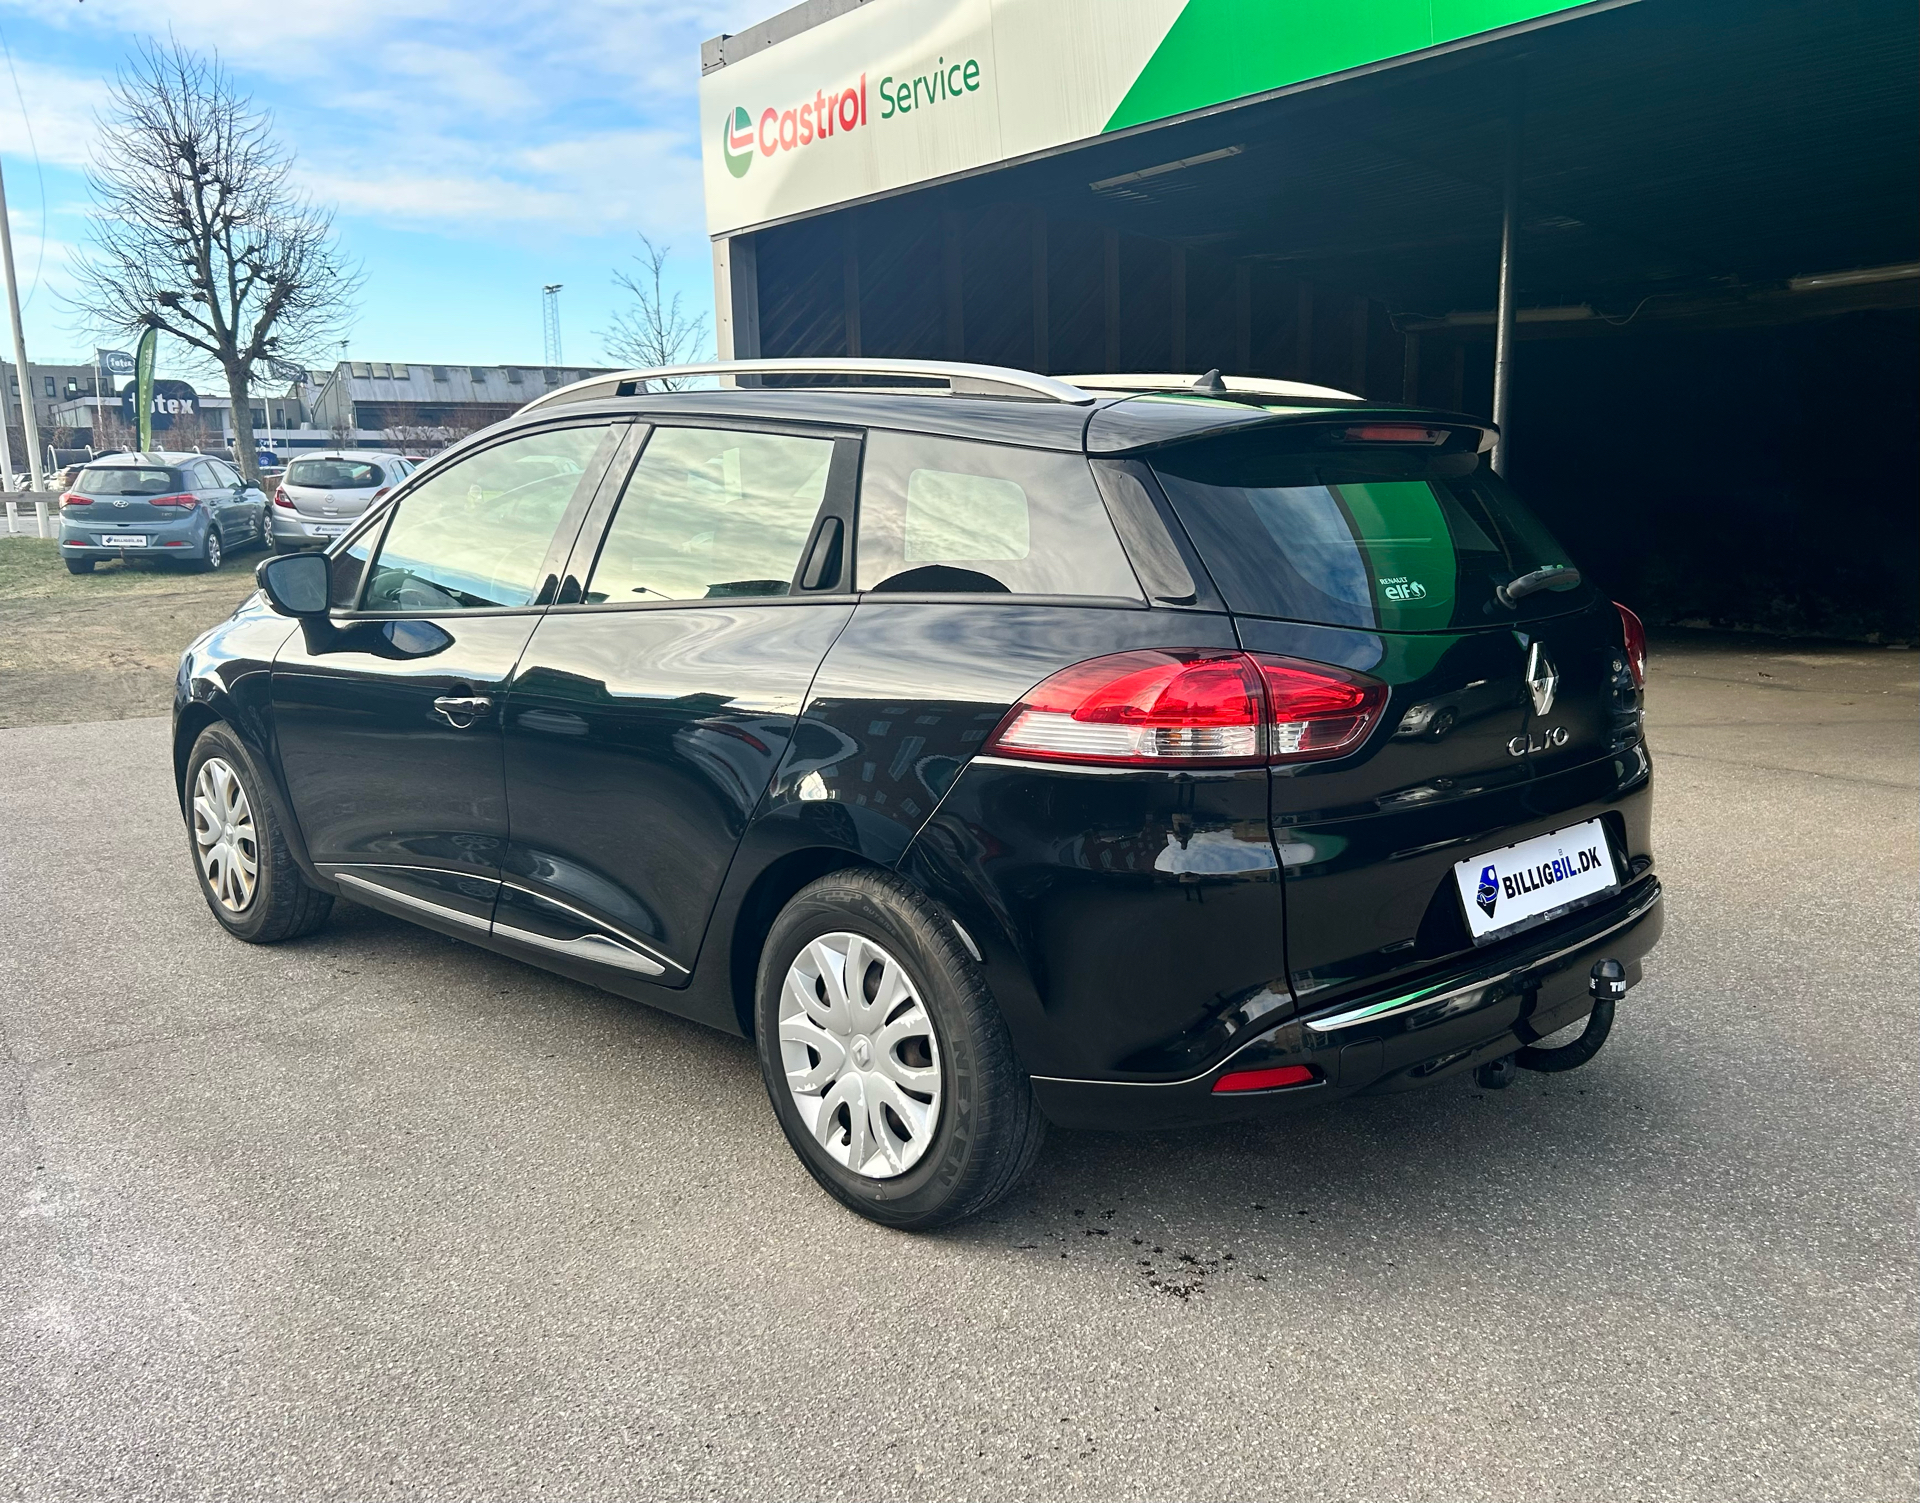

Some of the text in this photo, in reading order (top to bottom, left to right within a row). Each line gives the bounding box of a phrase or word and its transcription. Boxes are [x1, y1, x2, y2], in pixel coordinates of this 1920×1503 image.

[758, 56, 980, 157] Castrol Service
[1379, 576, 1408, 585] RENAULT
[1385, 584, 1410, 600] elf
[1506, 726, 1570, 757] CLIO
[1502, 847, 1602, 899] BILLIGBIL.DK
[862, 905, 897, 936] OUTSIDE
[939, 1040, 972, 1187] NEXEN
